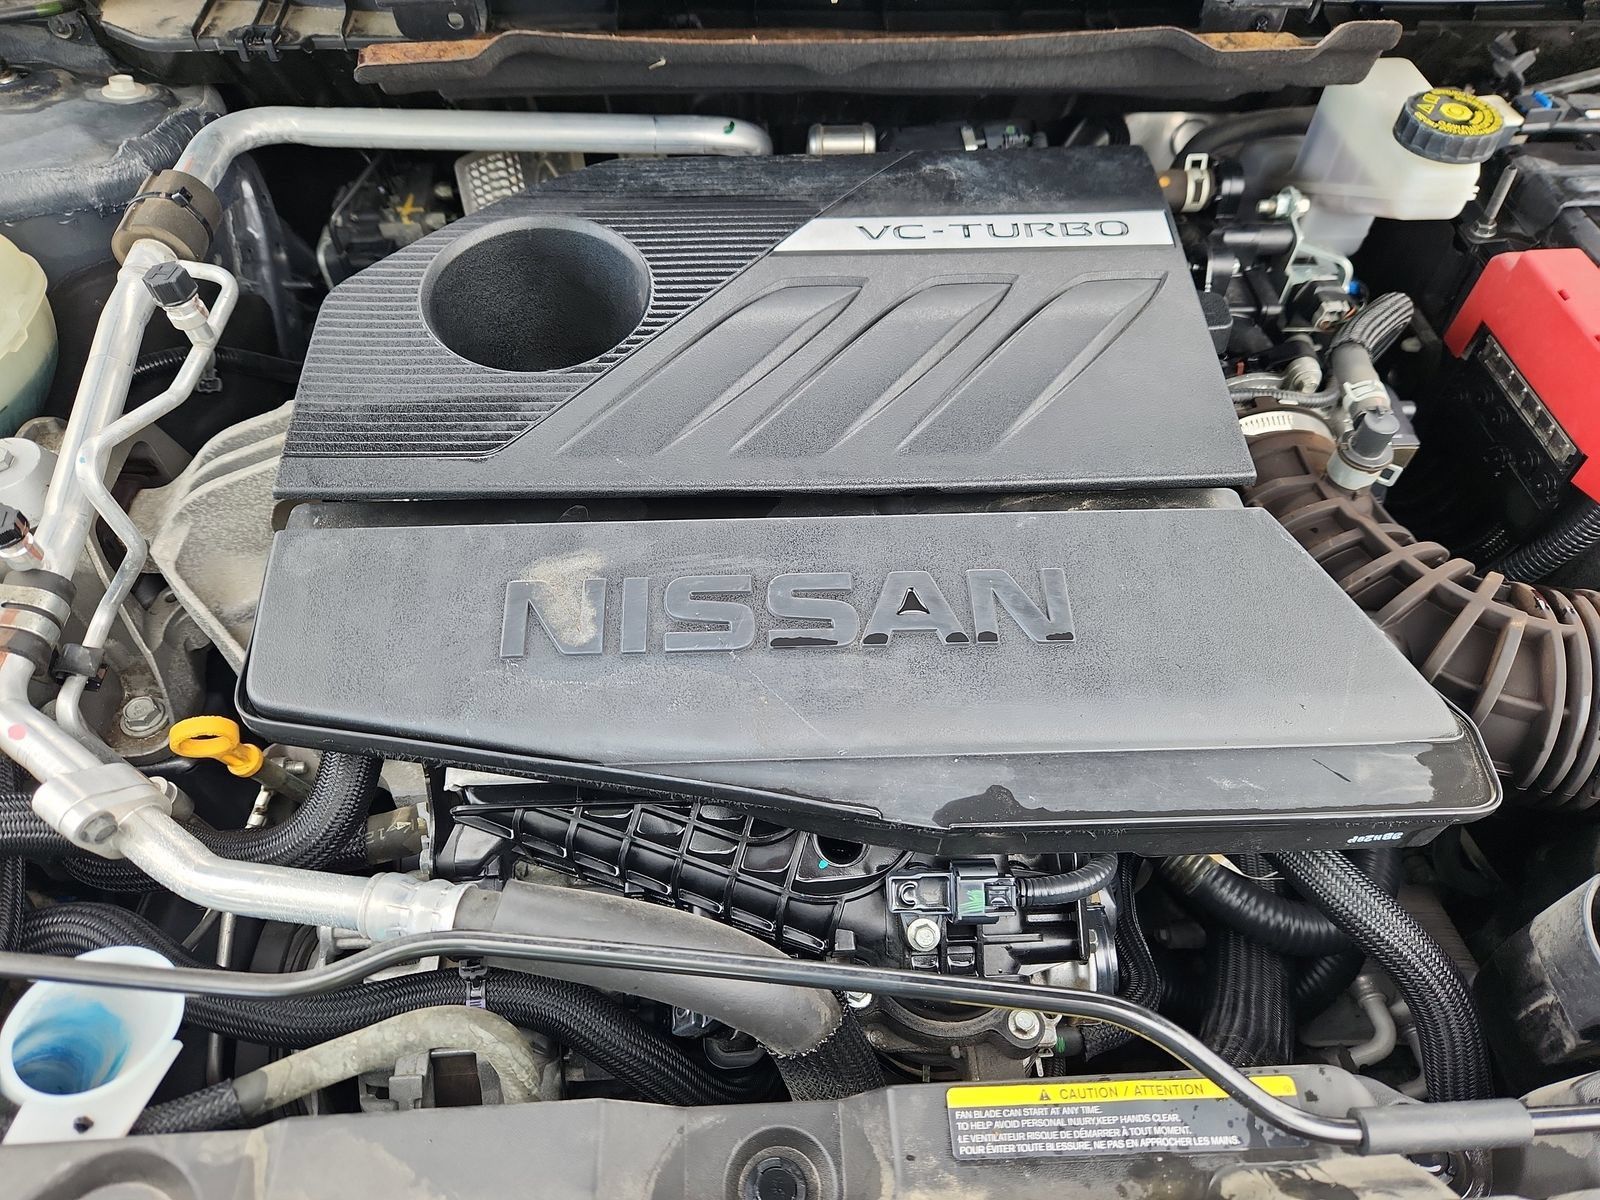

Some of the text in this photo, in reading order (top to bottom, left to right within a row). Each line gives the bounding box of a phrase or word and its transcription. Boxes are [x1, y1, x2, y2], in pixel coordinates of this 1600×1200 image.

[856, 220, 1130, 241] VC-TURBO
[500, 567, 1076, 658] NISSAN
[1059, 1083, 1205, 1100] CAUTION / ATTENTION
[955, 1105, 1103, 1119] FAN BLADE CAN START AT ANY TIME.
[956, 1121, 969, 1131] TO
[970, 1120, 993, 1130] HELP
[994, 1119, 1020, 1129] AVOID
[1021, 1118, 1067, 1128] PERSONAL
[1120, 1114, 1151, 1124] HANDS
[1152, 1113, 1181, 1123] CLEAR.
[958, 1125, 1192, 1143] LE VENTILATEUR RISQUE DE DÉMARRER À TOUT MOMENT.
[959, 1135, 1241, 1155] POUR ÉVITER TOUTE BLESSURE, NE PAS EN APPROCHER LES MAINS.
